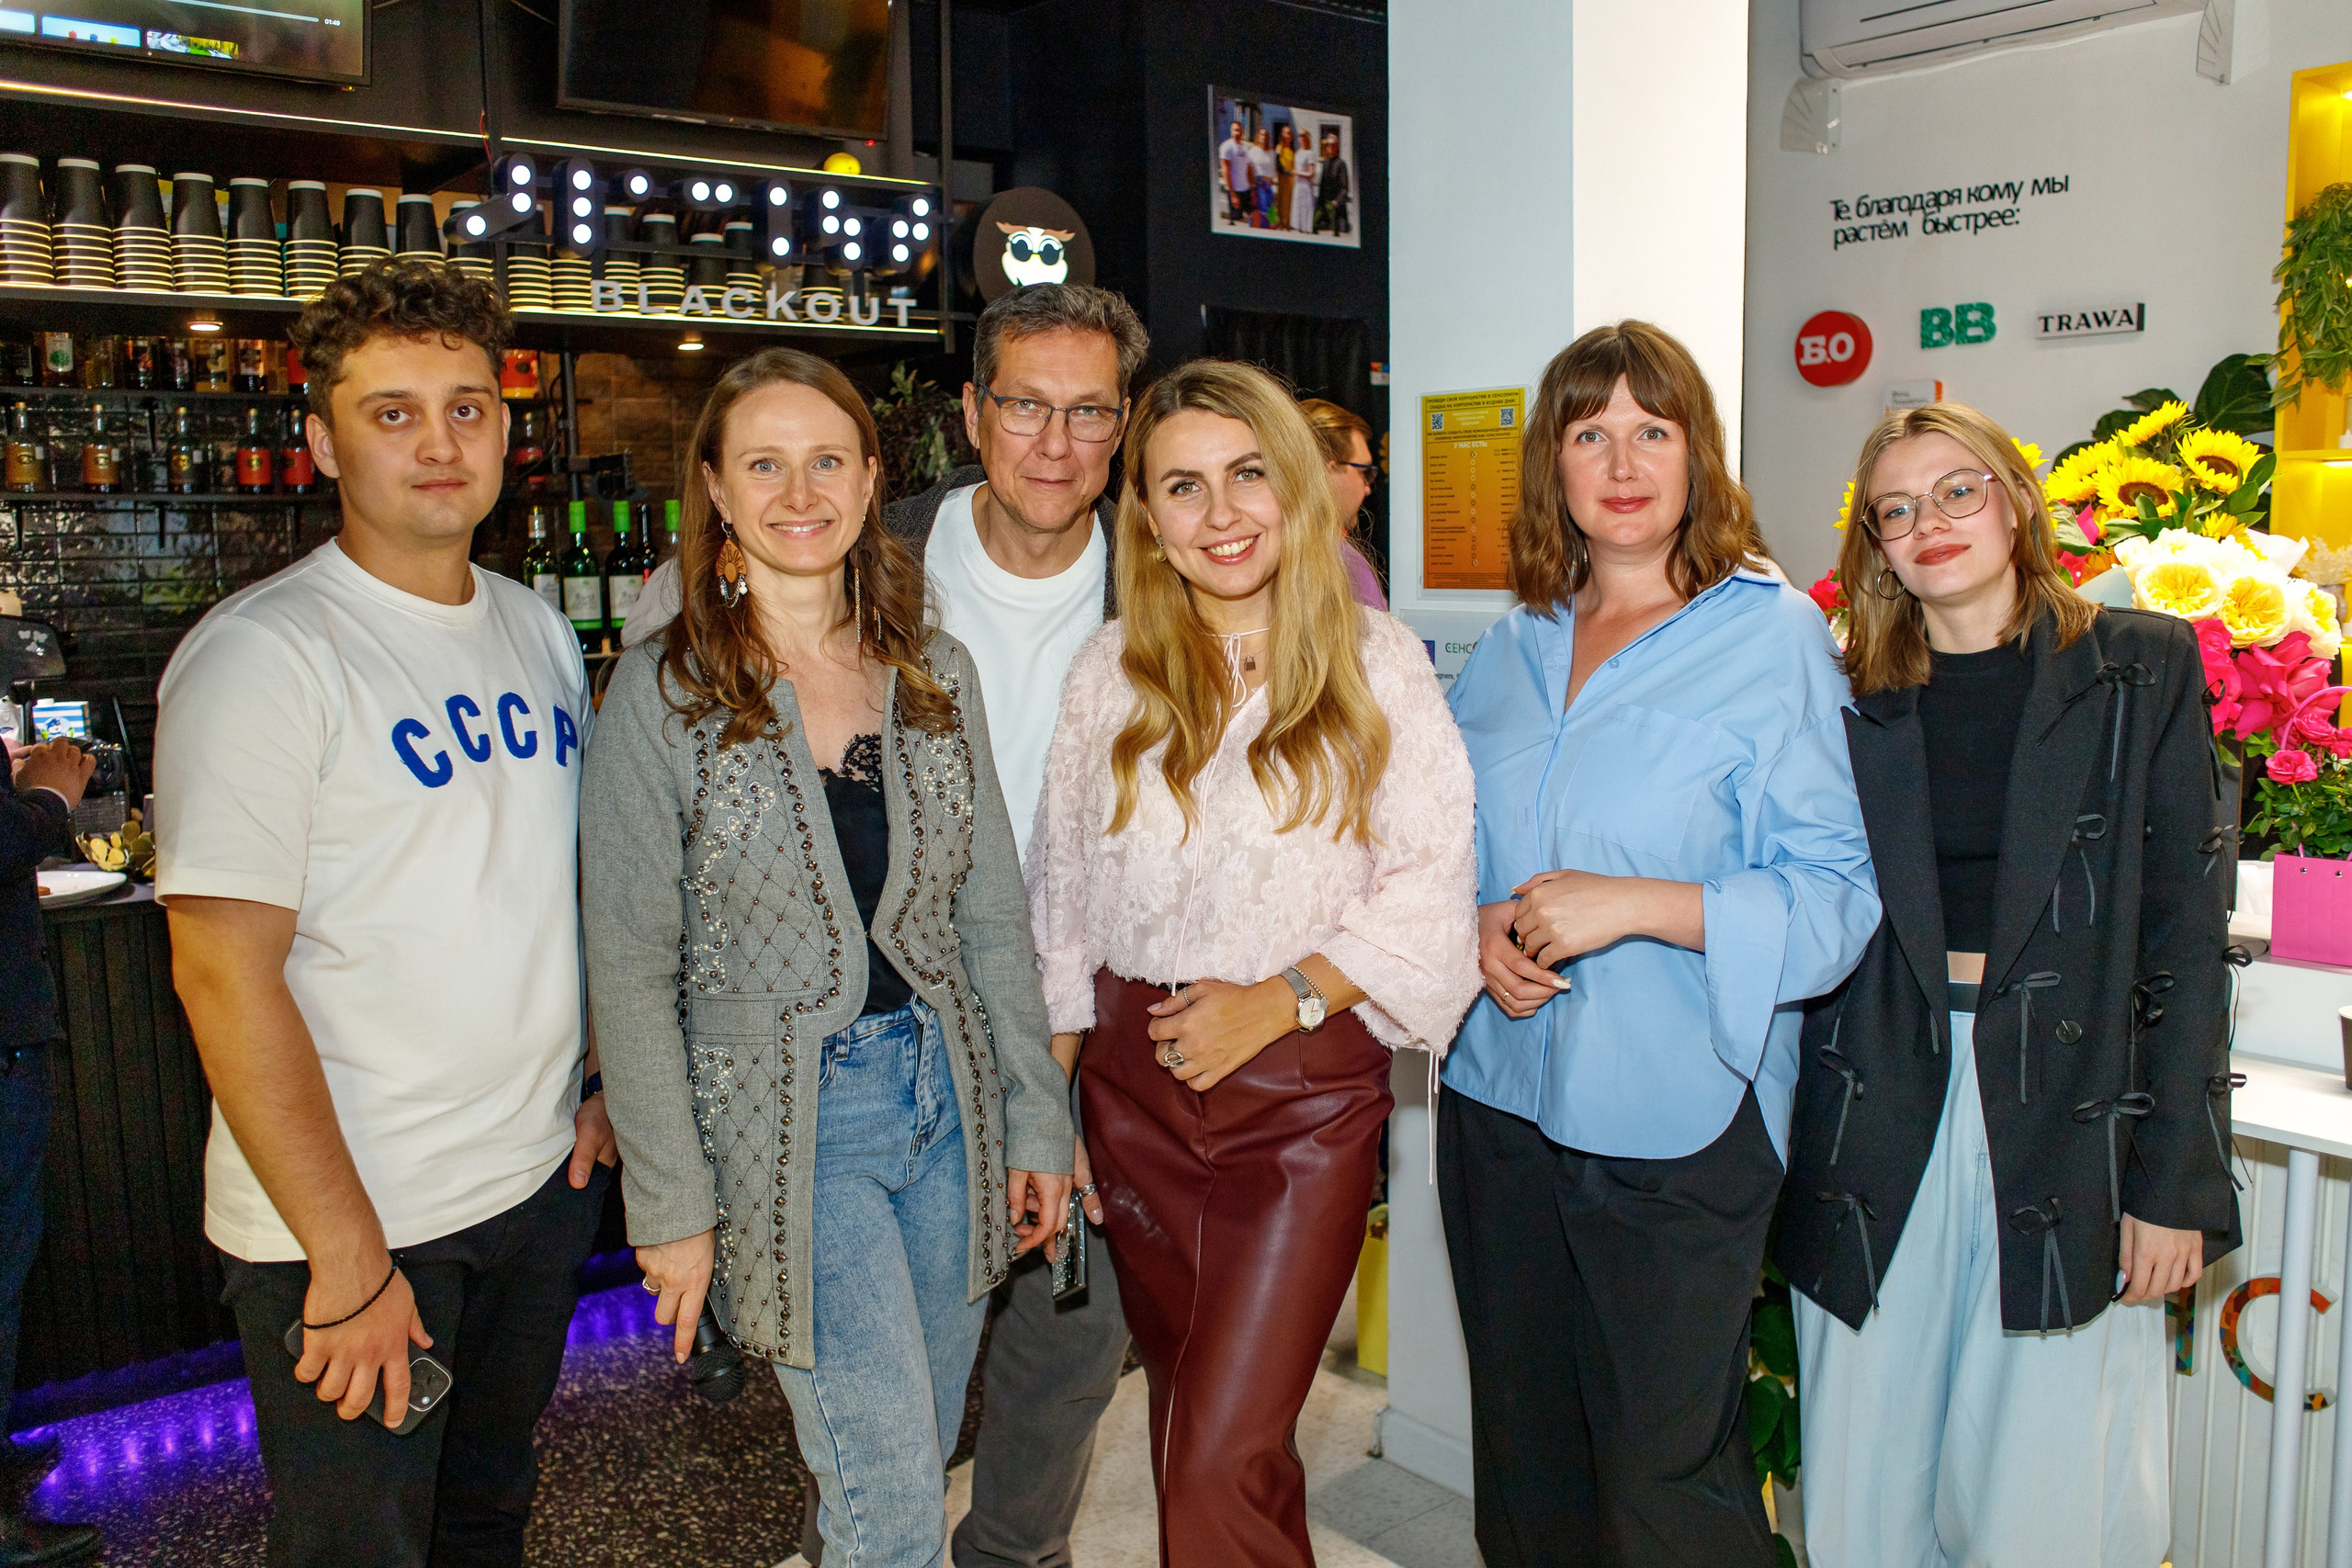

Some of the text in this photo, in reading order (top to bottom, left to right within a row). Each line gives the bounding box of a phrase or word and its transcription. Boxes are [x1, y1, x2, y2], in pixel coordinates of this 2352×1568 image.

[1856, 187, 1962, 217] благодаря
[1967, 181, 2024, 205] кому
[2031, 175, 2069, 196] мы
[1834, 208, 2020, 251] растём быстрее:
[591, 279, 917, 327] BLACKOUT
[2037, 309, 2134, 333] TRAWA
[391, 692, 578, 788] СССР
